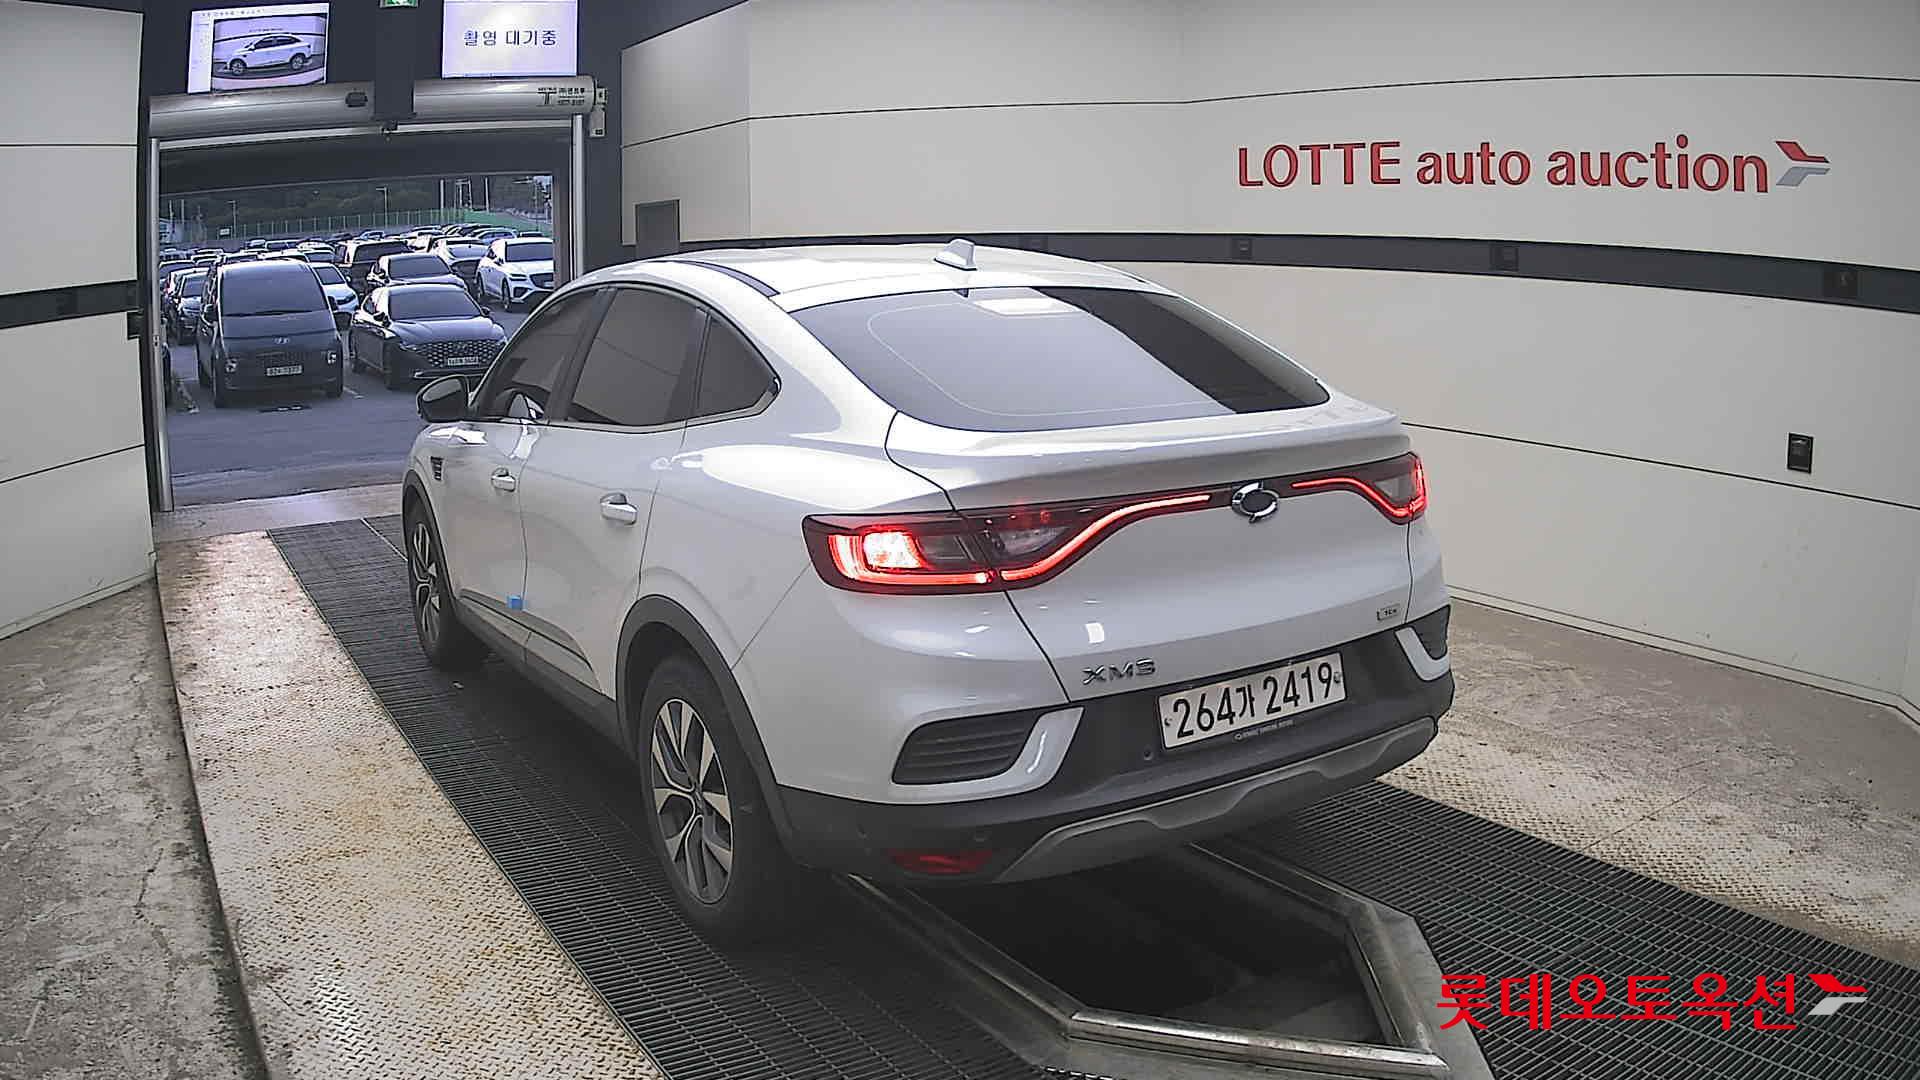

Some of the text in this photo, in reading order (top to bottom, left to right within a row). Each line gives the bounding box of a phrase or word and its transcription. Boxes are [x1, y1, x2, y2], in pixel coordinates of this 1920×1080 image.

[464, 30, 557, 47] 촬영 대기중
[1238, 133, 1769, 193] LOTTE auto auction
[1082, 657, 1156, 686] XM3
[1173, 684, 1255, 739] 264가
[1263, 662, 1333, 715] 2419
